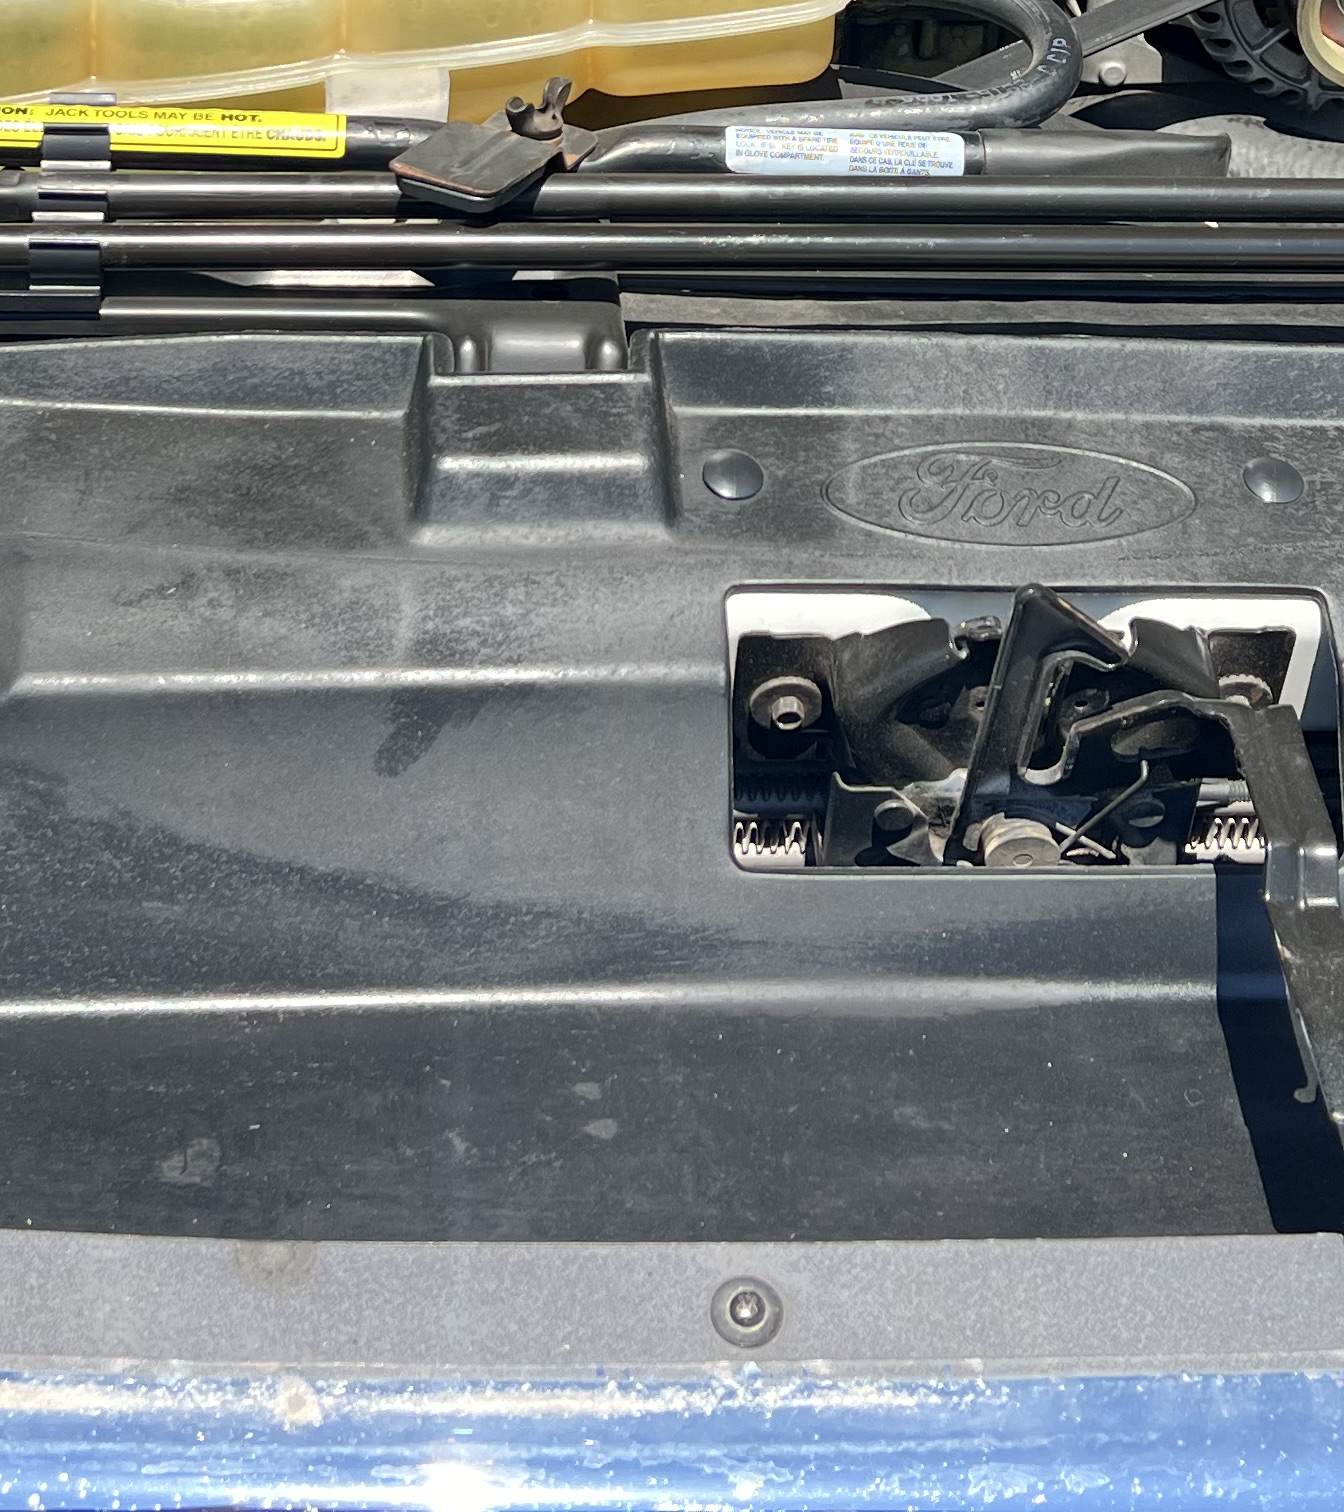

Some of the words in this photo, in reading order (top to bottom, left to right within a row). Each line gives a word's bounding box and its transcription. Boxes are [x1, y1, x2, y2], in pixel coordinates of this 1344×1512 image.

[45, 108, 90, 117] JACK
[94, 109, 149, 119] TOOLS
[153, 111, 187, 120] MAY
[193, 112, 216, 121] BE
[221, 114, 263, 123] HOT.
[849, 155, 867, 164] DANS
[928, 160, 954, 169] TROUVE
[898, 450, 1124, 529] Ford
